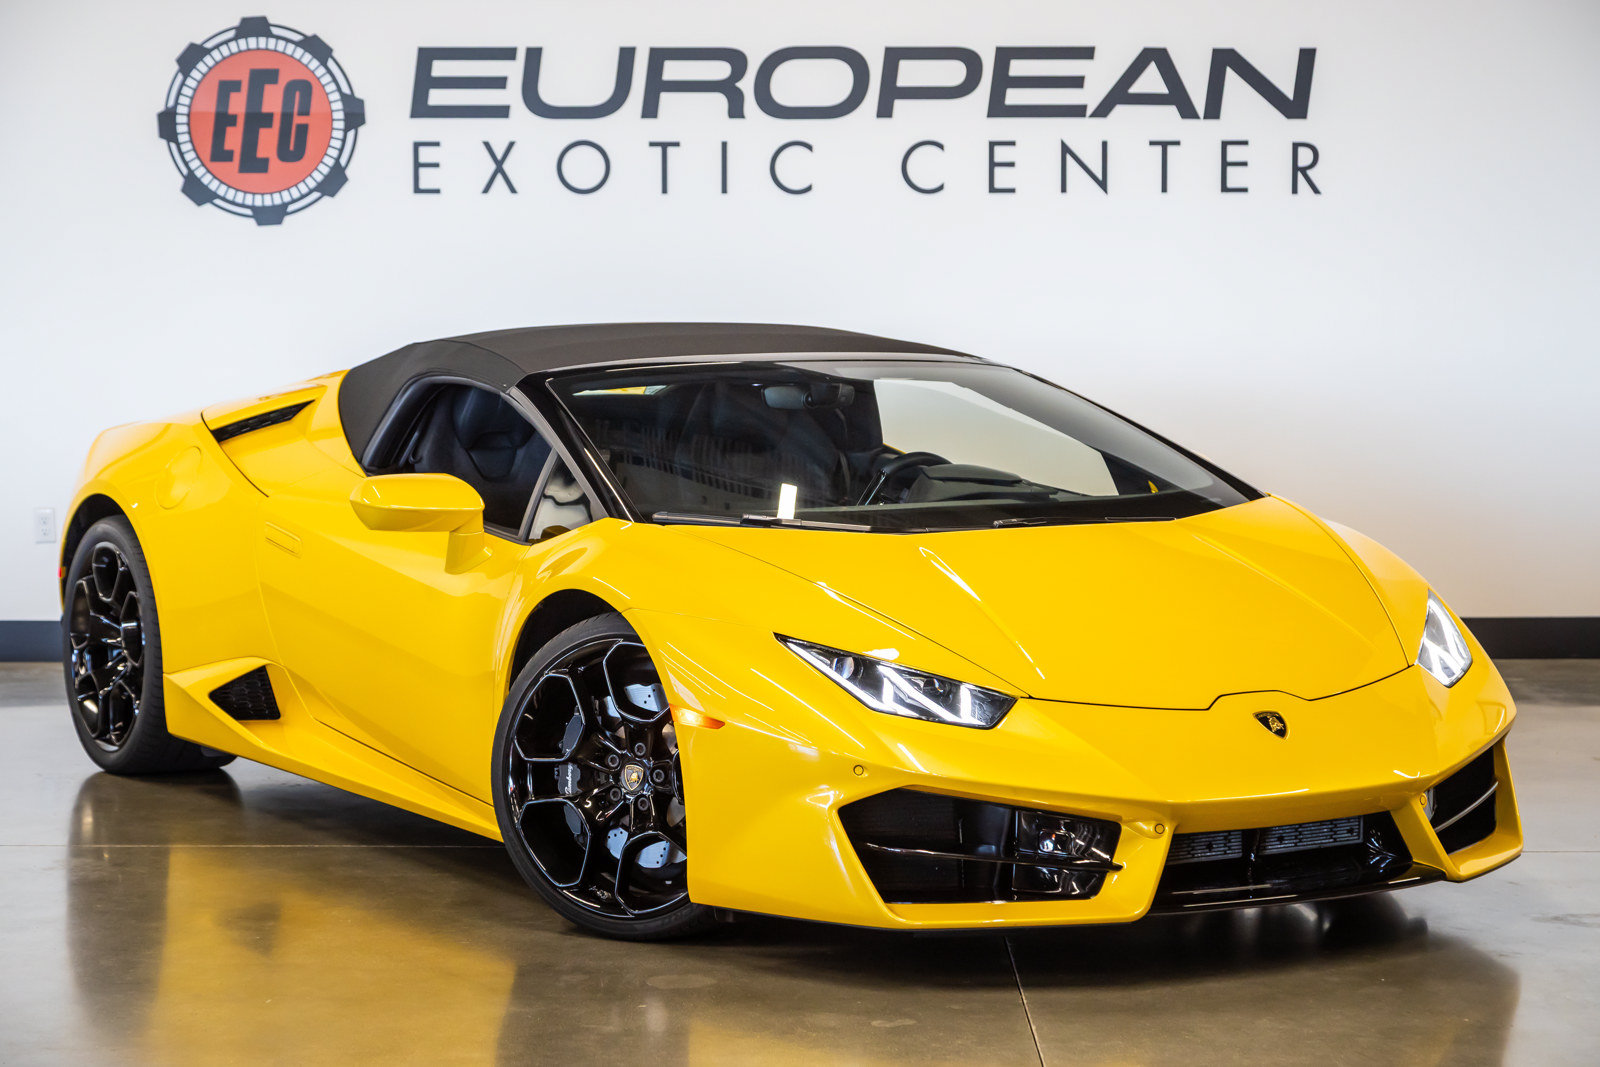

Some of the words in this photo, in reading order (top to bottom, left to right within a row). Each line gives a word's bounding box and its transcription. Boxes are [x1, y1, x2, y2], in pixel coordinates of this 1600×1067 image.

[410, 46, 1317, 119] EUROPEAN
[210, 68, 313, 174] EEC
[413, 140, 813, 194] EXOTIC
[902, 140, 1321, 194] CENTER
